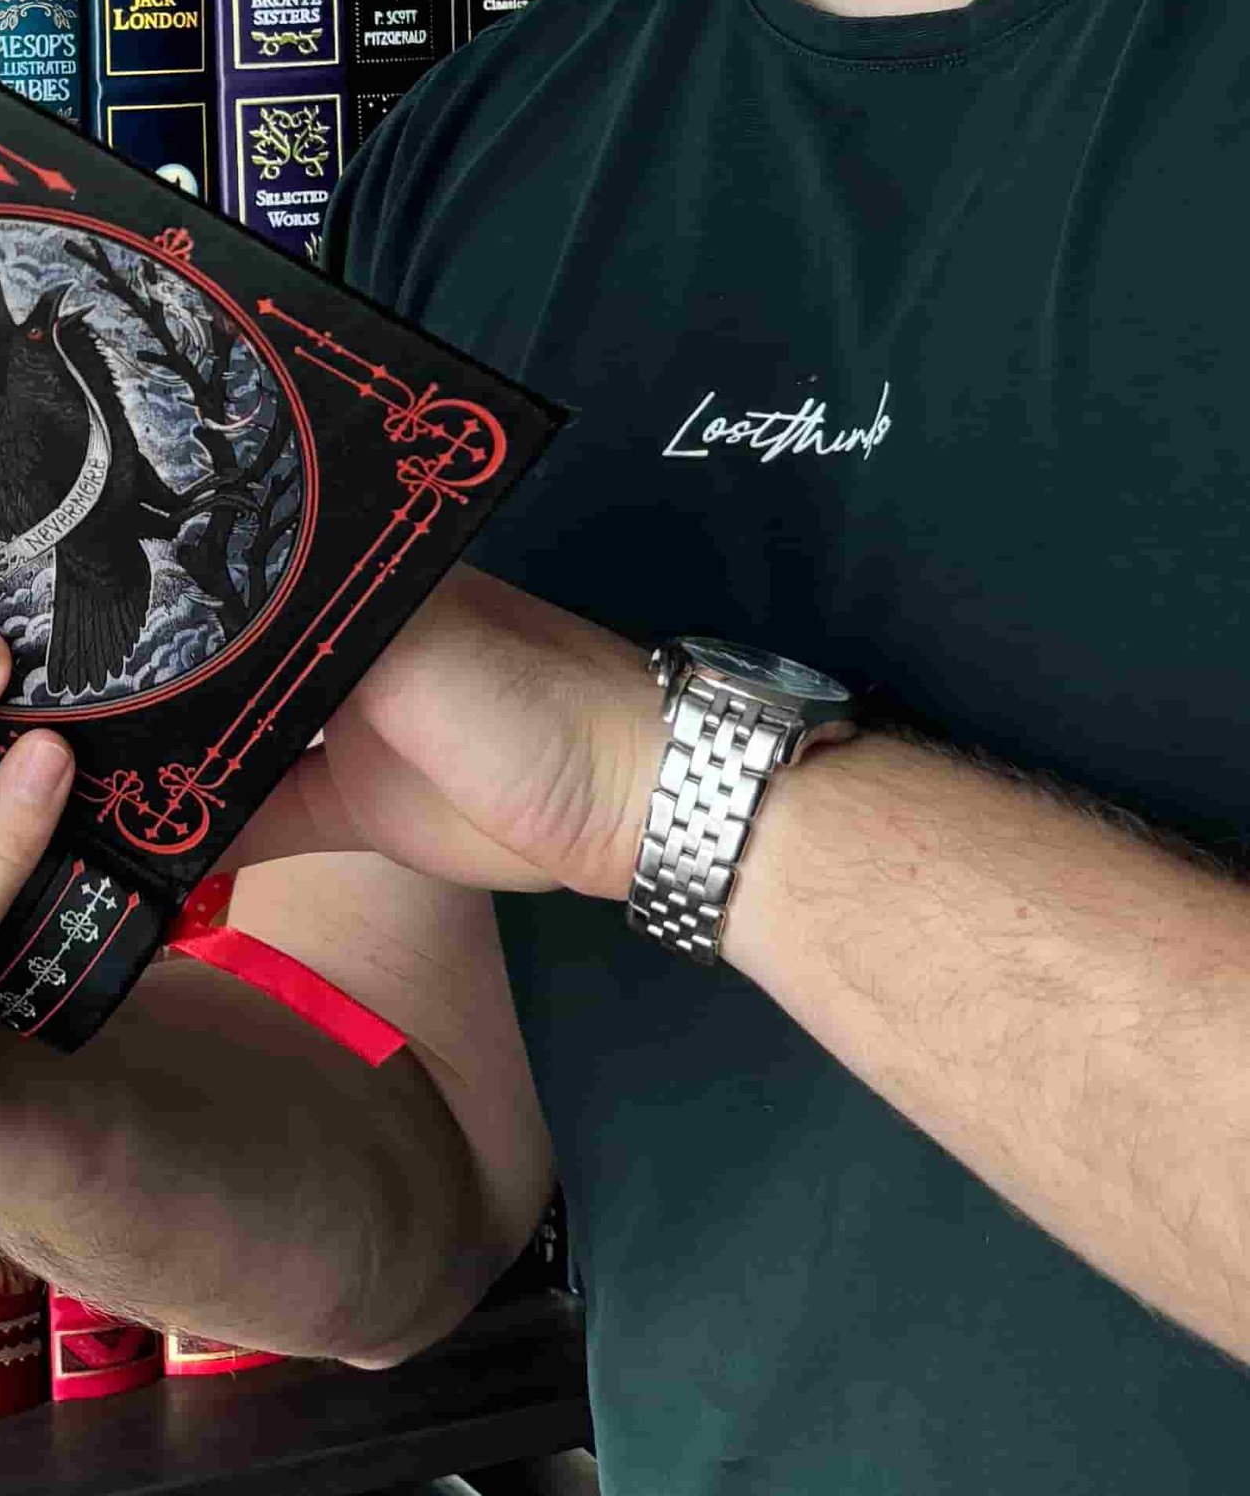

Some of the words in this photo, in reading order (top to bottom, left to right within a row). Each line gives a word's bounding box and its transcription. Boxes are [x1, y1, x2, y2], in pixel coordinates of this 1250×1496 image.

[112, 9, 198, 31] LONDON
[252, 8, 321, 26] SISTERS
[386, 9, 418, 25] SCOTT
[364, 30, 427, 46] FITZGERALD
[255, 189, 329, 207] SELECTED
[267, 210, 320, 229] WORKS
